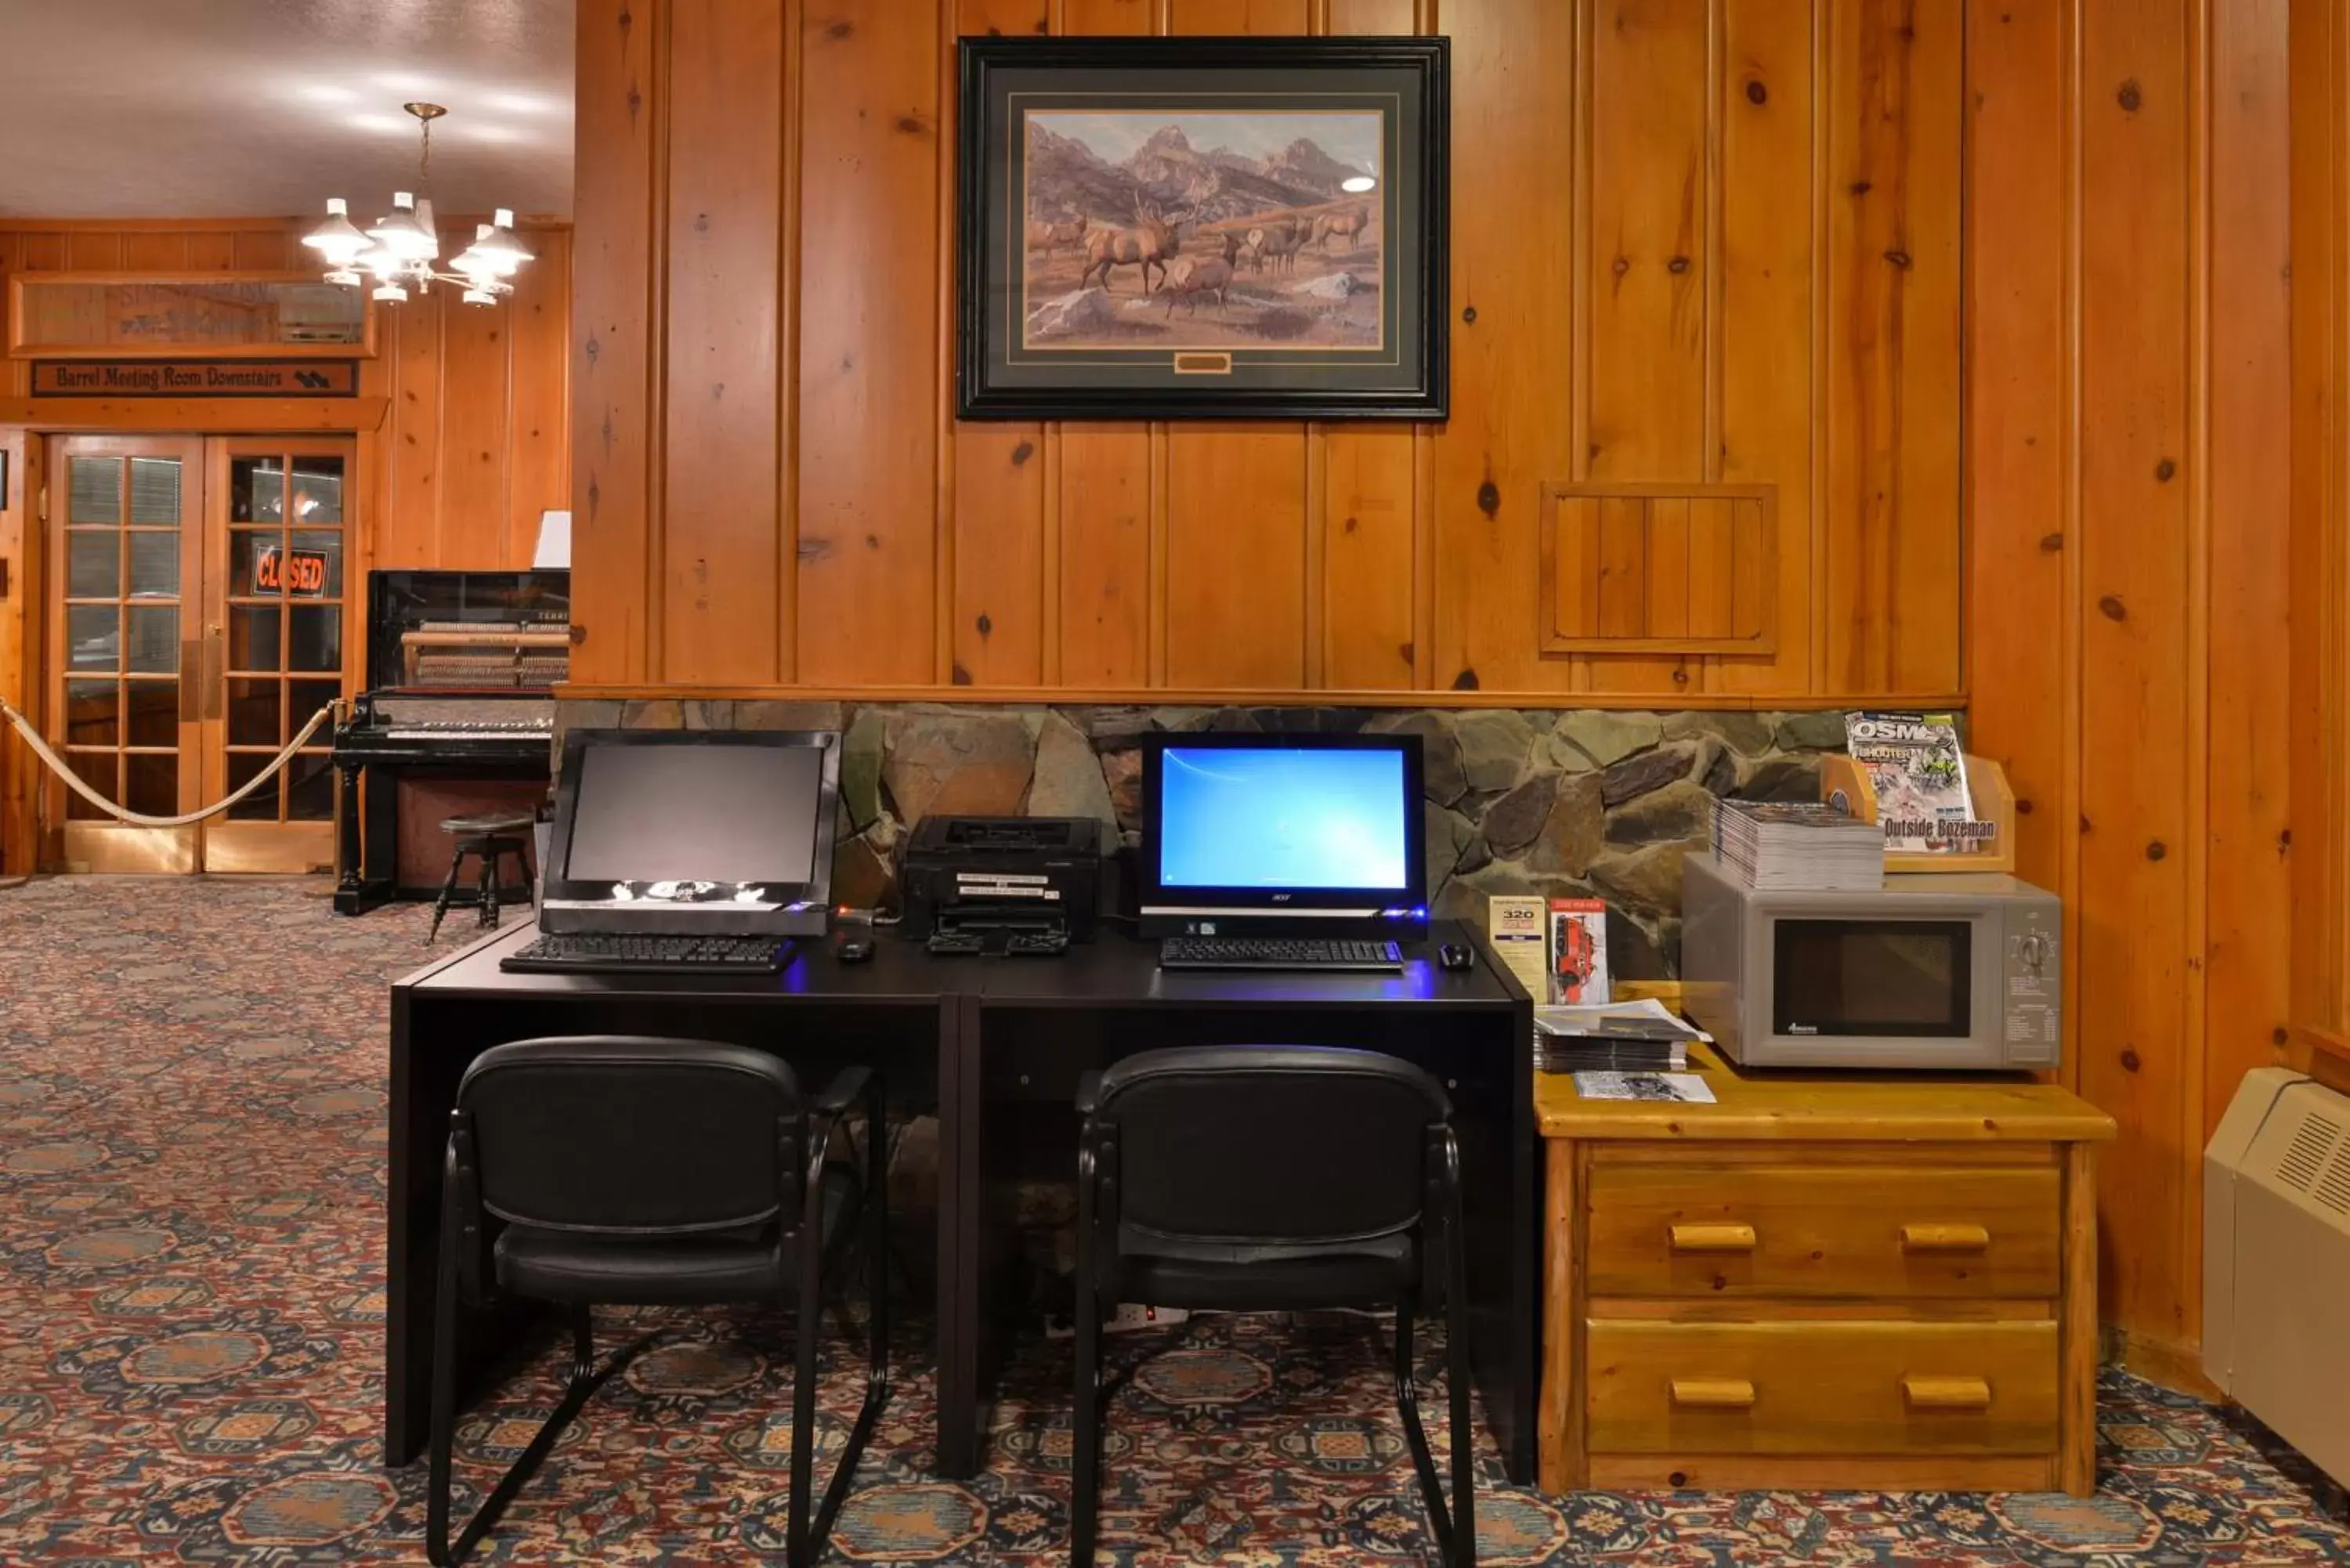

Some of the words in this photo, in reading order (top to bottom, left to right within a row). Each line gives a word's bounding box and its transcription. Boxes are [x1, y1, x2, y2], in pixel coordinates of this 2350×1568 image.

[56, 367, 99, 387] Barrel
[105, 367, 159, 392] Meeting
[164, 366, 201, 386] Room
[208, 367, 281, 388] Downstairs
[1885, 818, 1933, 837] Outside
[1937, 818, 1994, 838] Bozeman
[1503, 910, 1535, 919] 320
